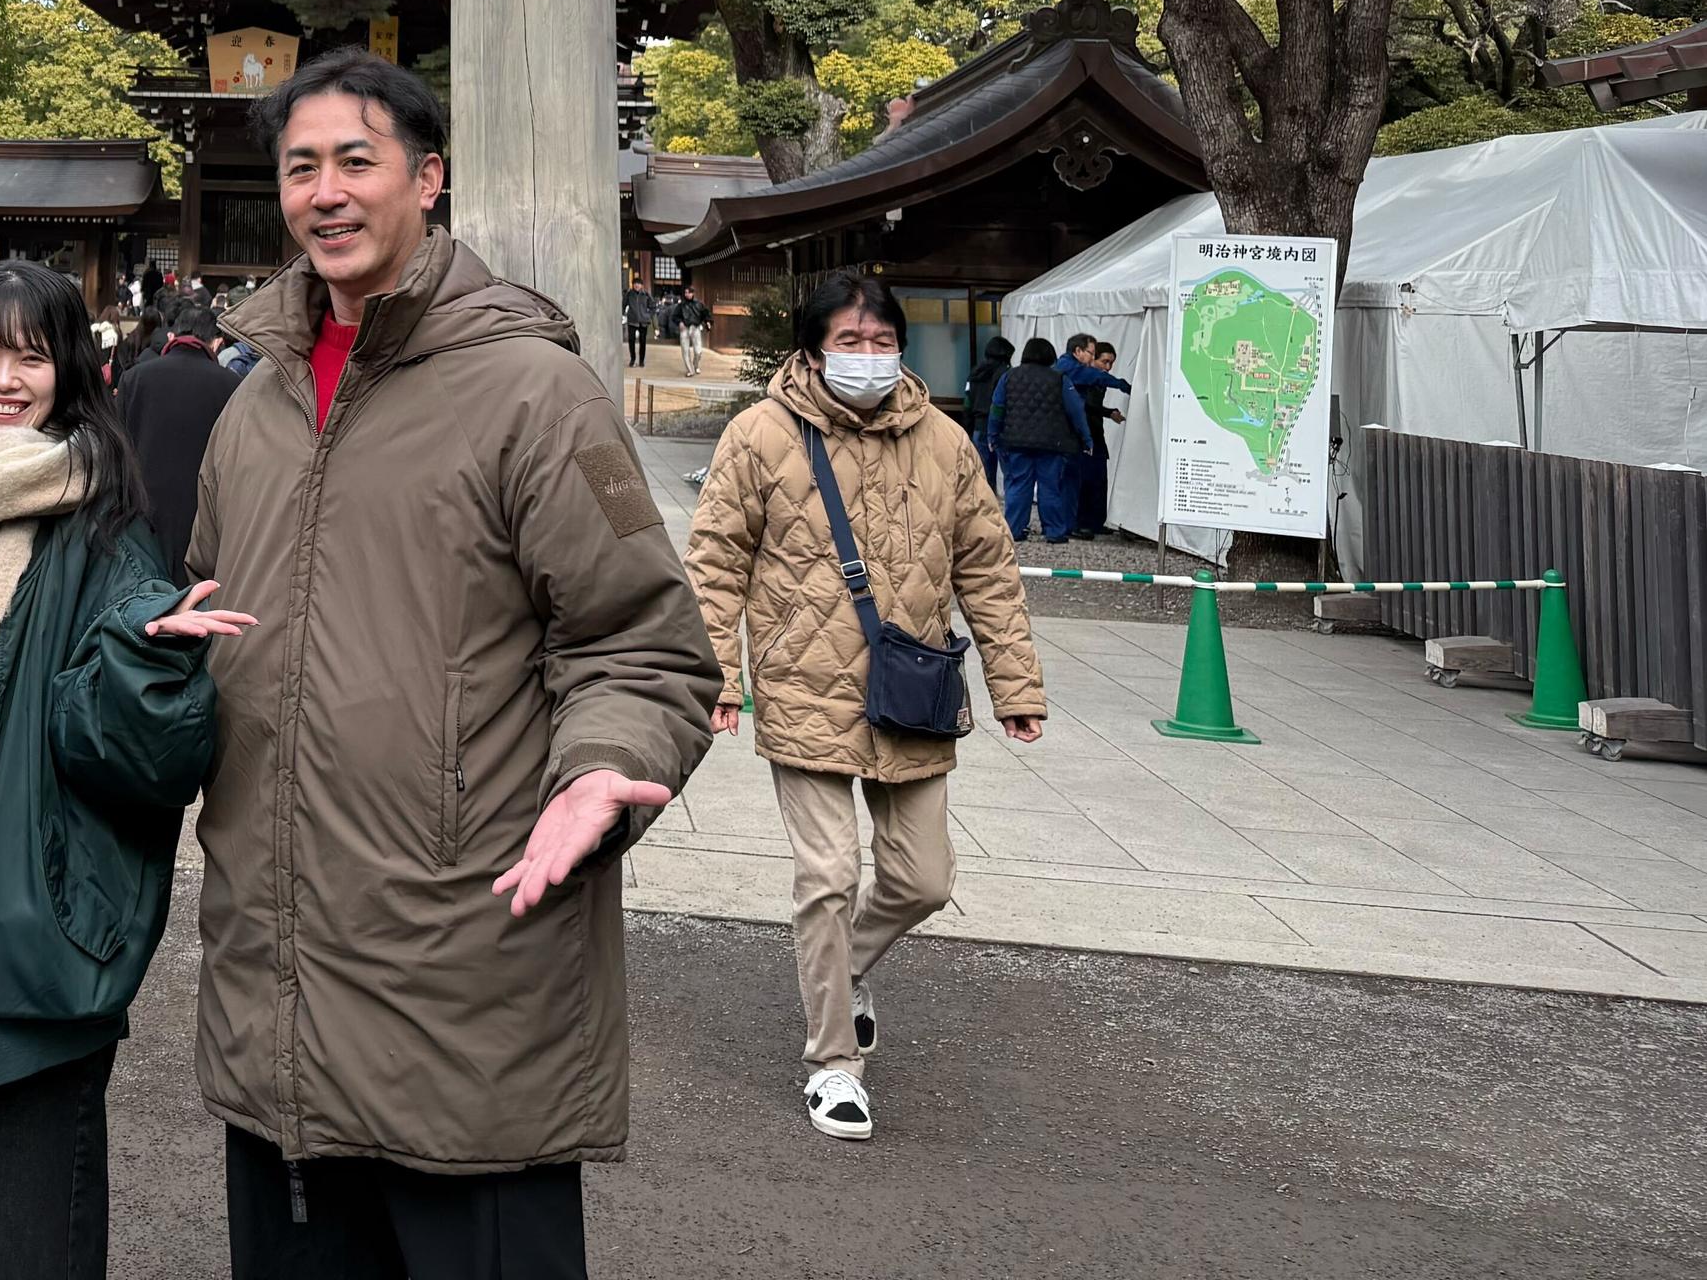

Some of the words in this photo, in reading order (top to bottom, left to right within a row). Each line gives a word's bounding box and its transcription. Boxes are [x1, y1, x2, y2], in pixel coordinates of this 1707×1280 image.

[1199, 243, 1317, 262] 明治神宮境内図
